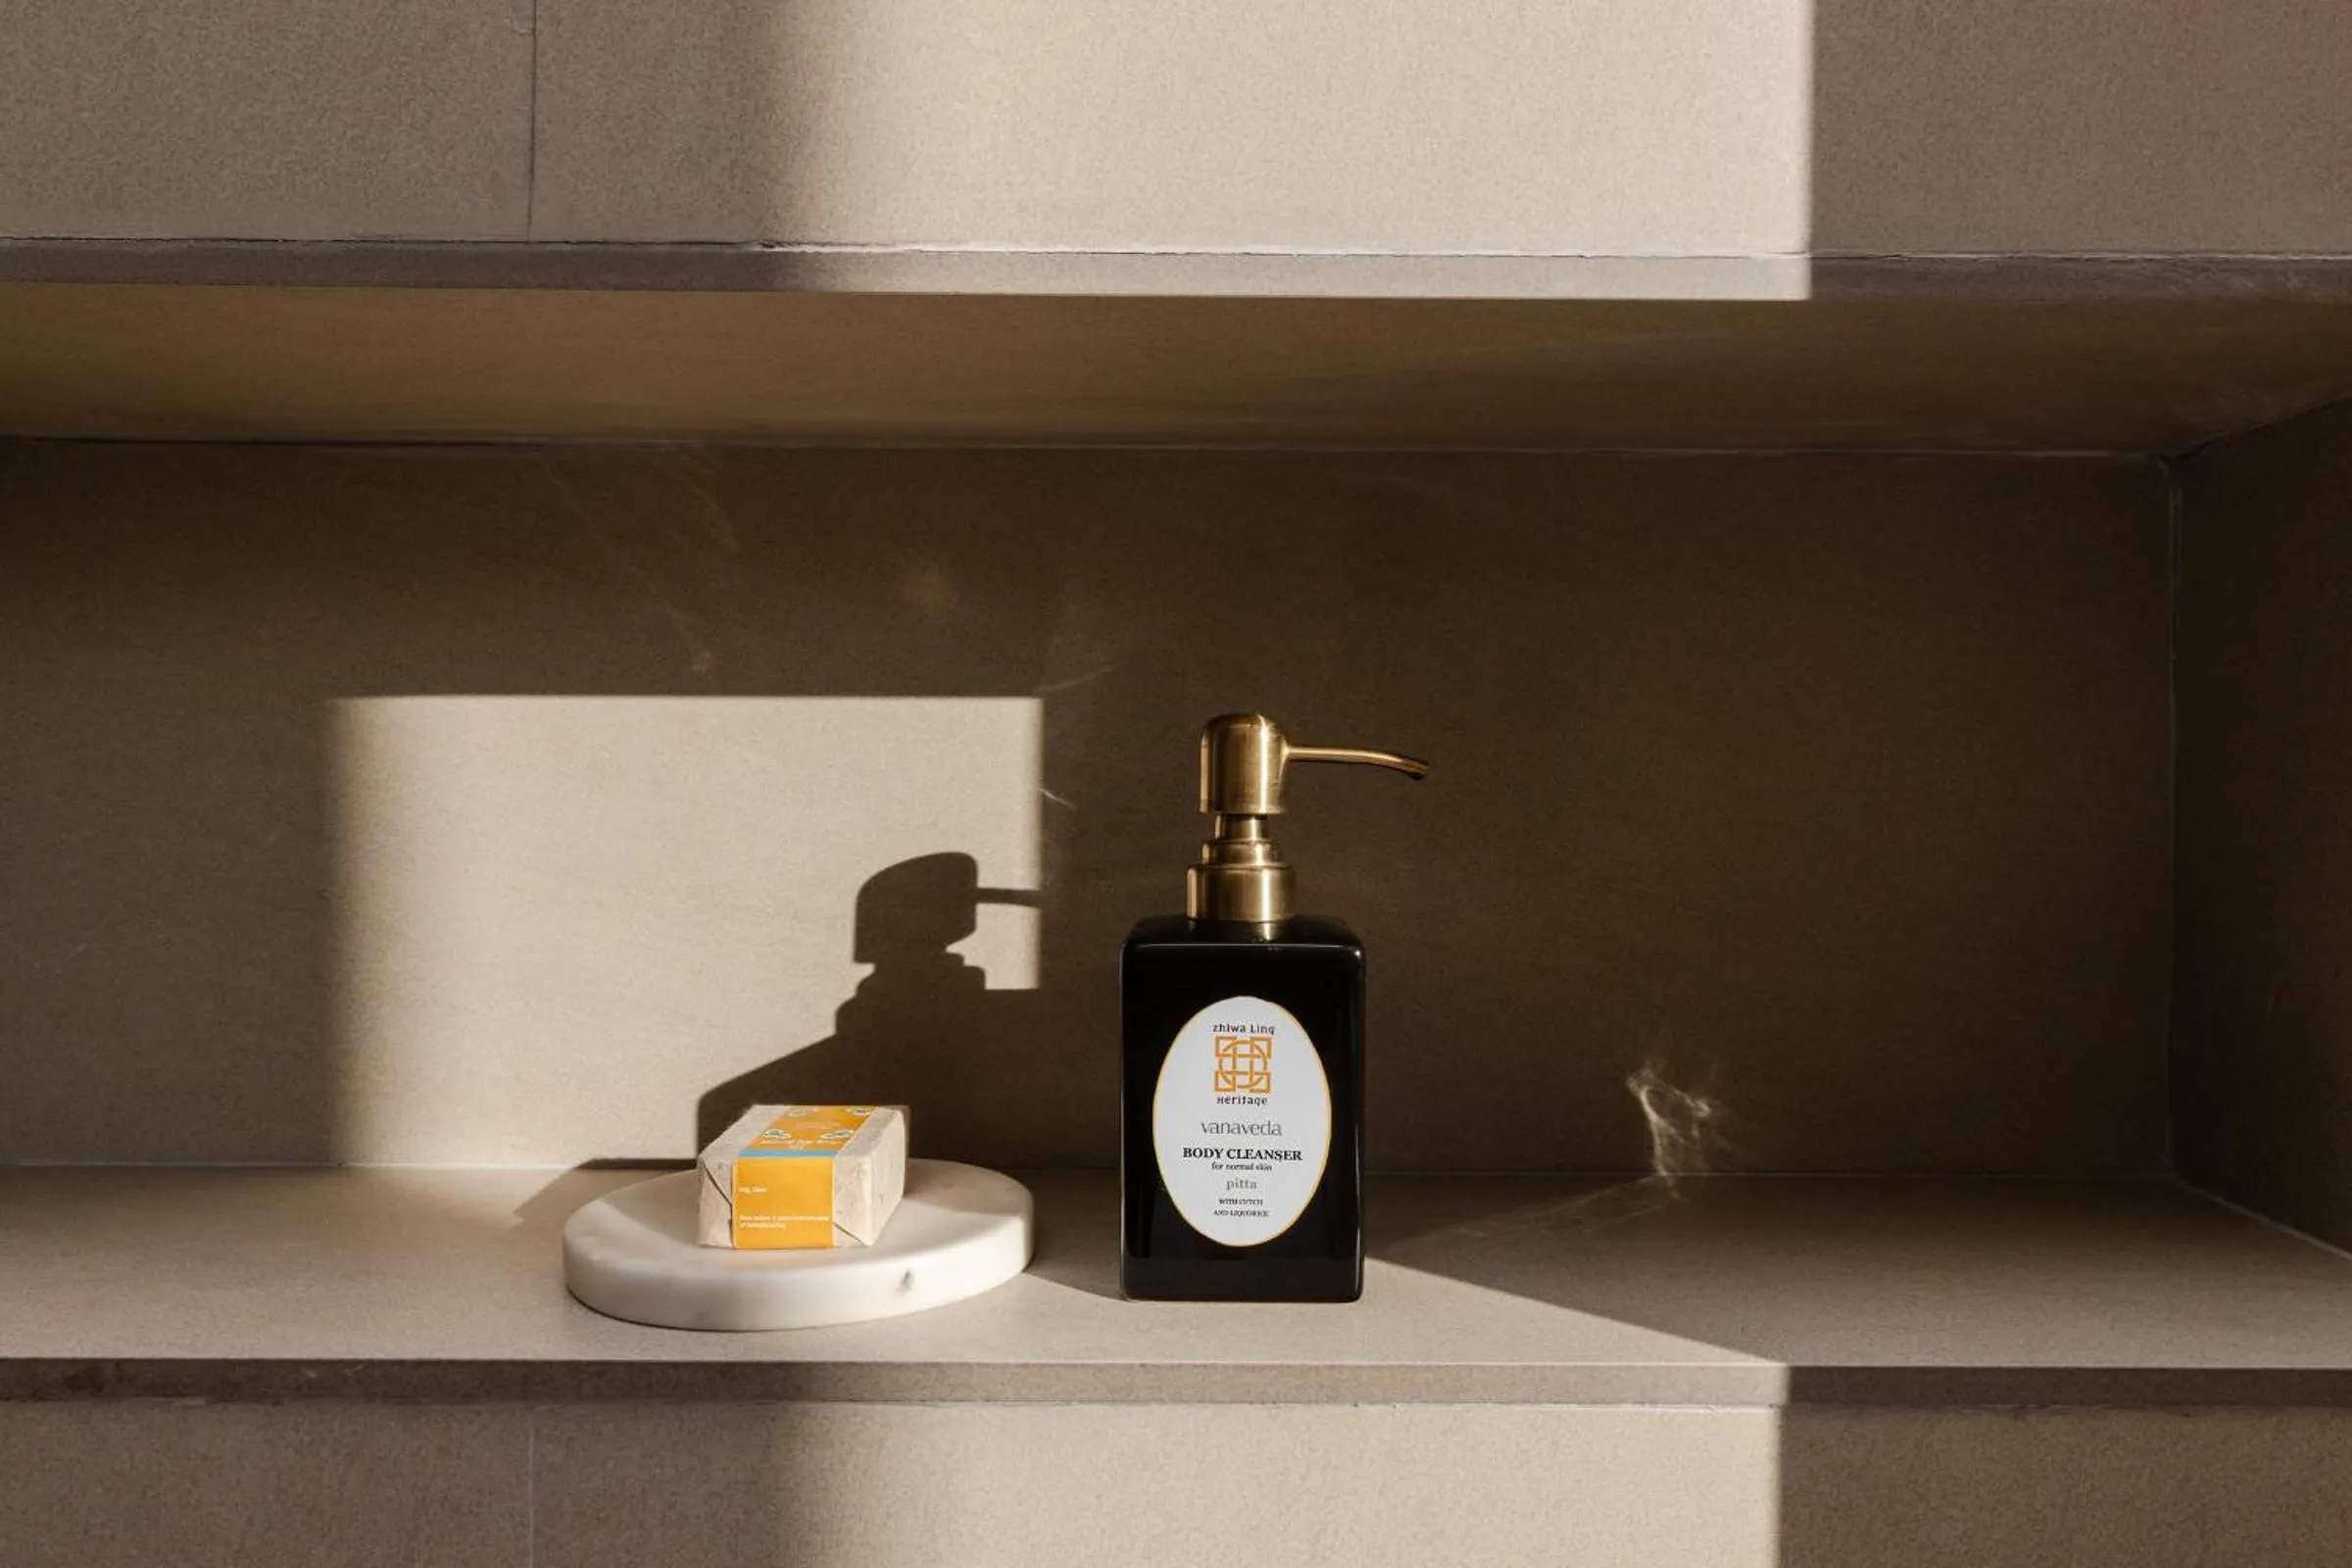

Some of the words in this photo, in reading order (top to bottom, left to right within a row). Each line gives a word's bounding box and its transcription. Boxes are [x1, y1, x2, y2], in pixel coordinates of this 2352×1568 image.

[1200, 1120, 1283, 1137] vanaveda
[1183, 1148, 1224, 1159] BODY
[1226, 1149, 1302, 1161] CLEANSER
[1211, 1161, 1223, 1170] for
[1225, 1161, 1254, 1171] normal
[1255, 1162, 1273, 1172] skin
[1226, 1178, 1257, 1192] pitta
